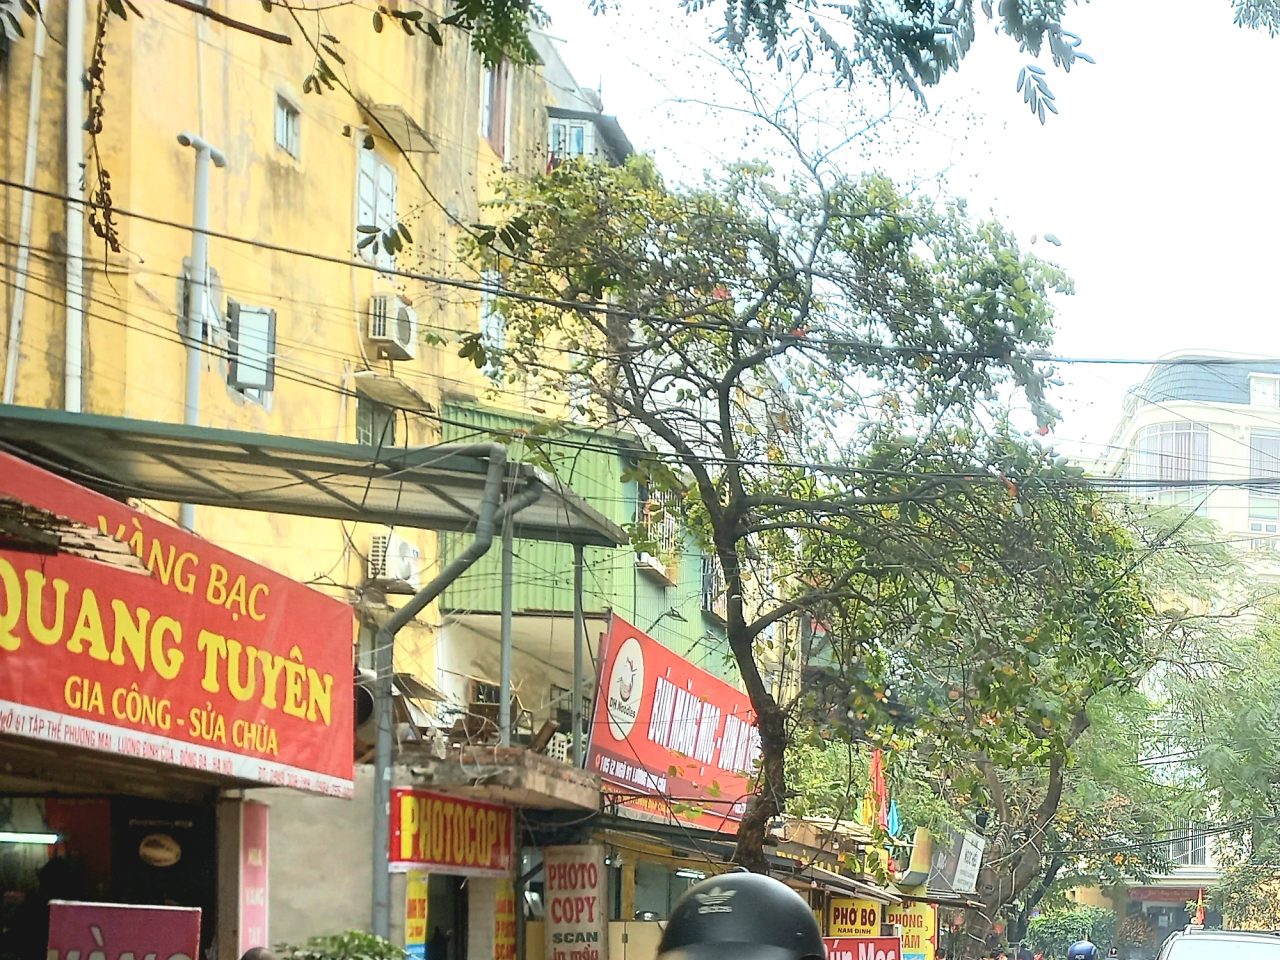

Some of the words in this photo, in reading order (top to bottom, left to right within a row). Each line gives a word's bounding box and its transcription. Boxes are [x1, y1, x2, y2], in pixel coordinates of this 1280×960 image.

[206, 563, 270, 622] BẠC
[0, 556, 184, 680] QUANG
[197, 629, 334, 727] TUYÊN
[64, 675, 105, 715] GIA
[111, 682, 171, 731] CÔNG
[176, 717, 185, 726] -
[189, 702, 226, 745] SỬA
[400, 795, 506, 867] PHOTOCOPY
[548, 862, 598, 891] PHOTO
[551, 896, 597, 924] COPY
[833, 902, 858, 926] PHỞ
[861, 904, 876, 927] BÒ
[552, 931, 598, 944] SCAN
